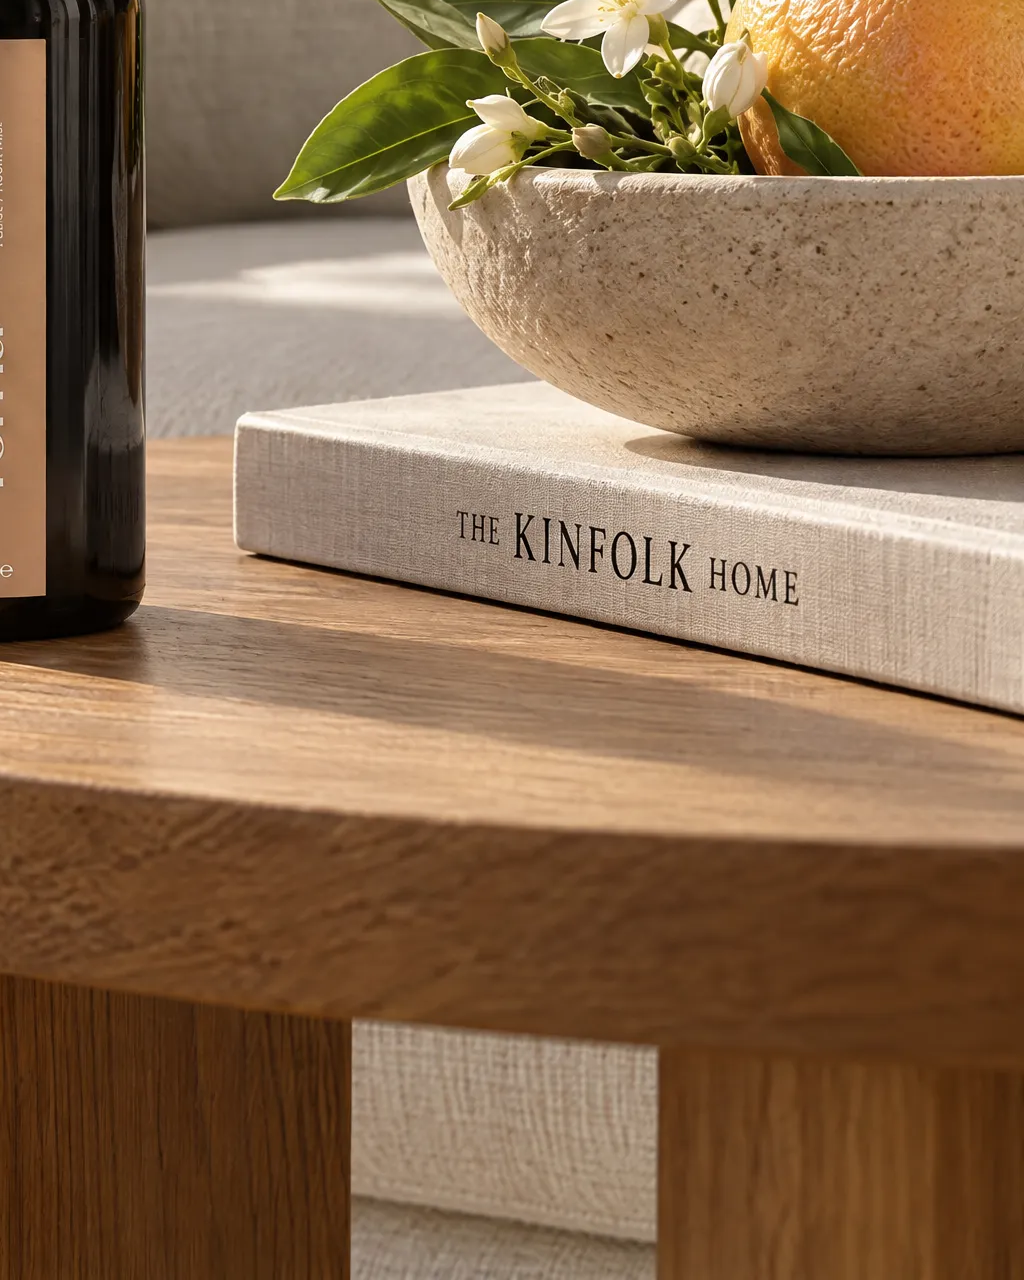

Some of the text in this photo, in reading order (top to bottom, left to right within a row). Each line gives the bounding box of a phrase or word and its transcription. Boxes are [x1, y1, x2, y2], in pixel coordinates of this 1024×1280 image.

[456, 510, 800, 607] THE KINFOLK HOME
